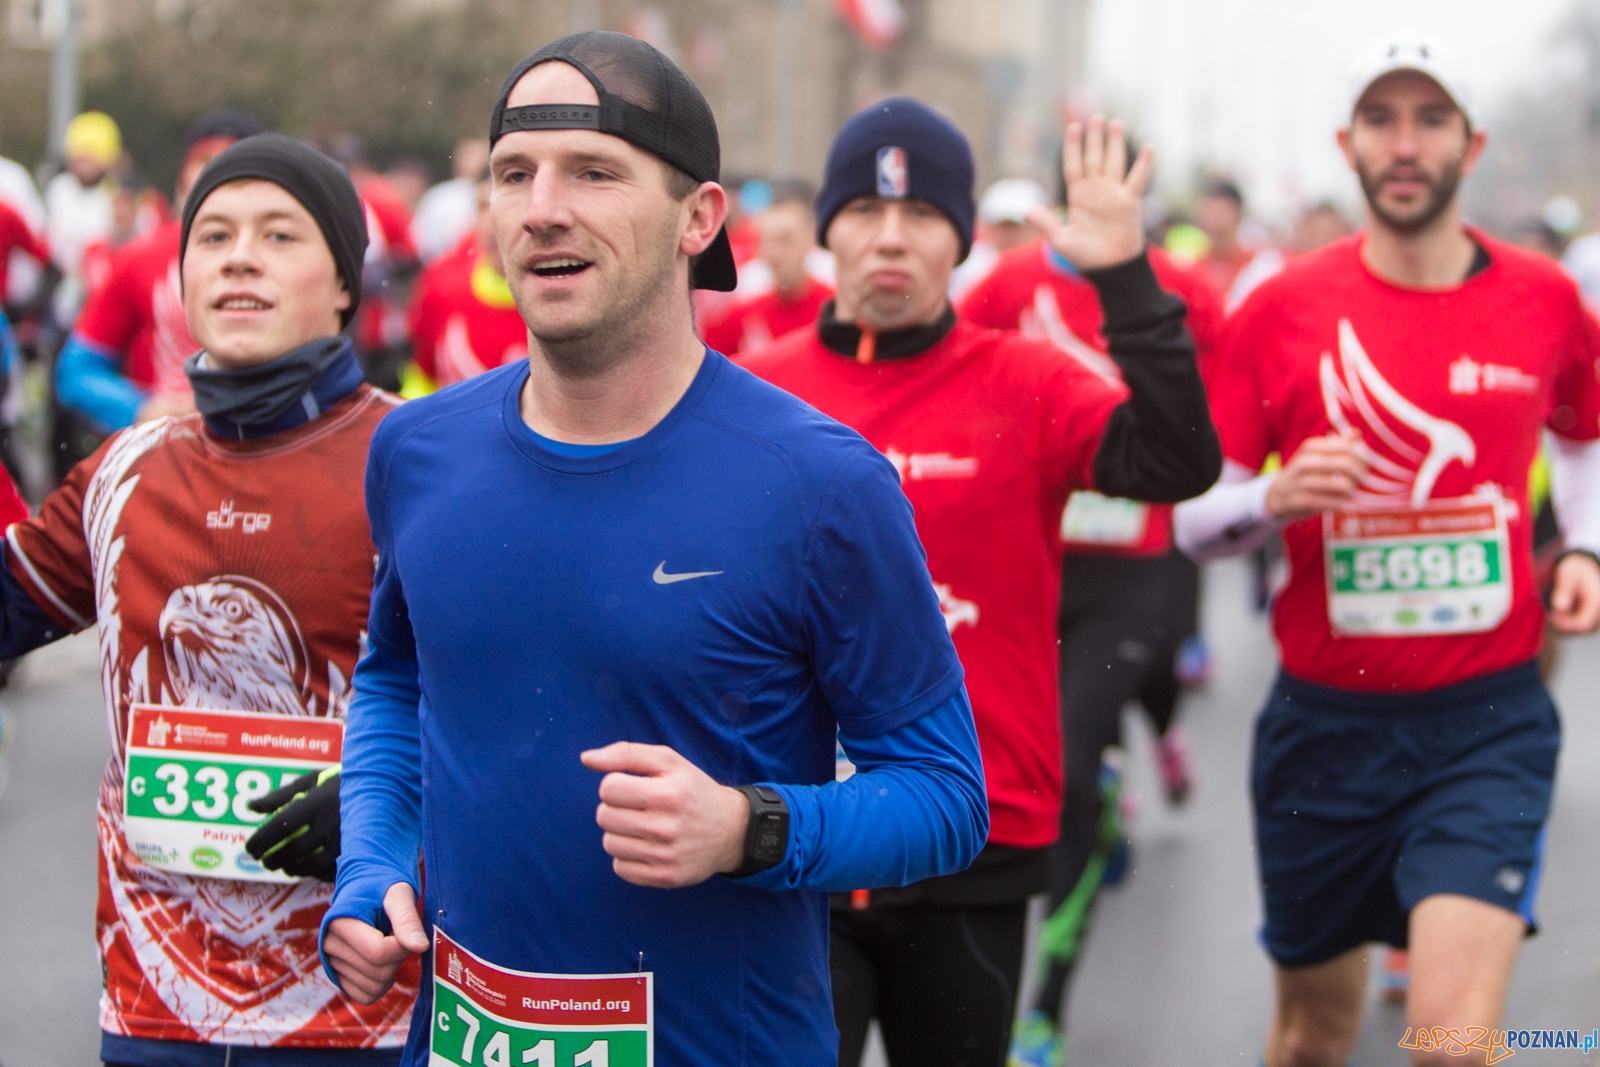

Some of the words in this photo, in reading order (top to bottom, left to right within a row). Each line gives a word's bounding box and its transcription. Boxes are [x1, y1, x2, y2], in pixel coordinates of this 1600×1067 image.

[1353, 541, 1490, 590] 5698
[241, 732, 329, 754] RunPoland.org
[153, 763, 302, 822] 338
[203, 829, 246, 844] Patryk
[521, 997, 631, 1013] RunPoland.org
